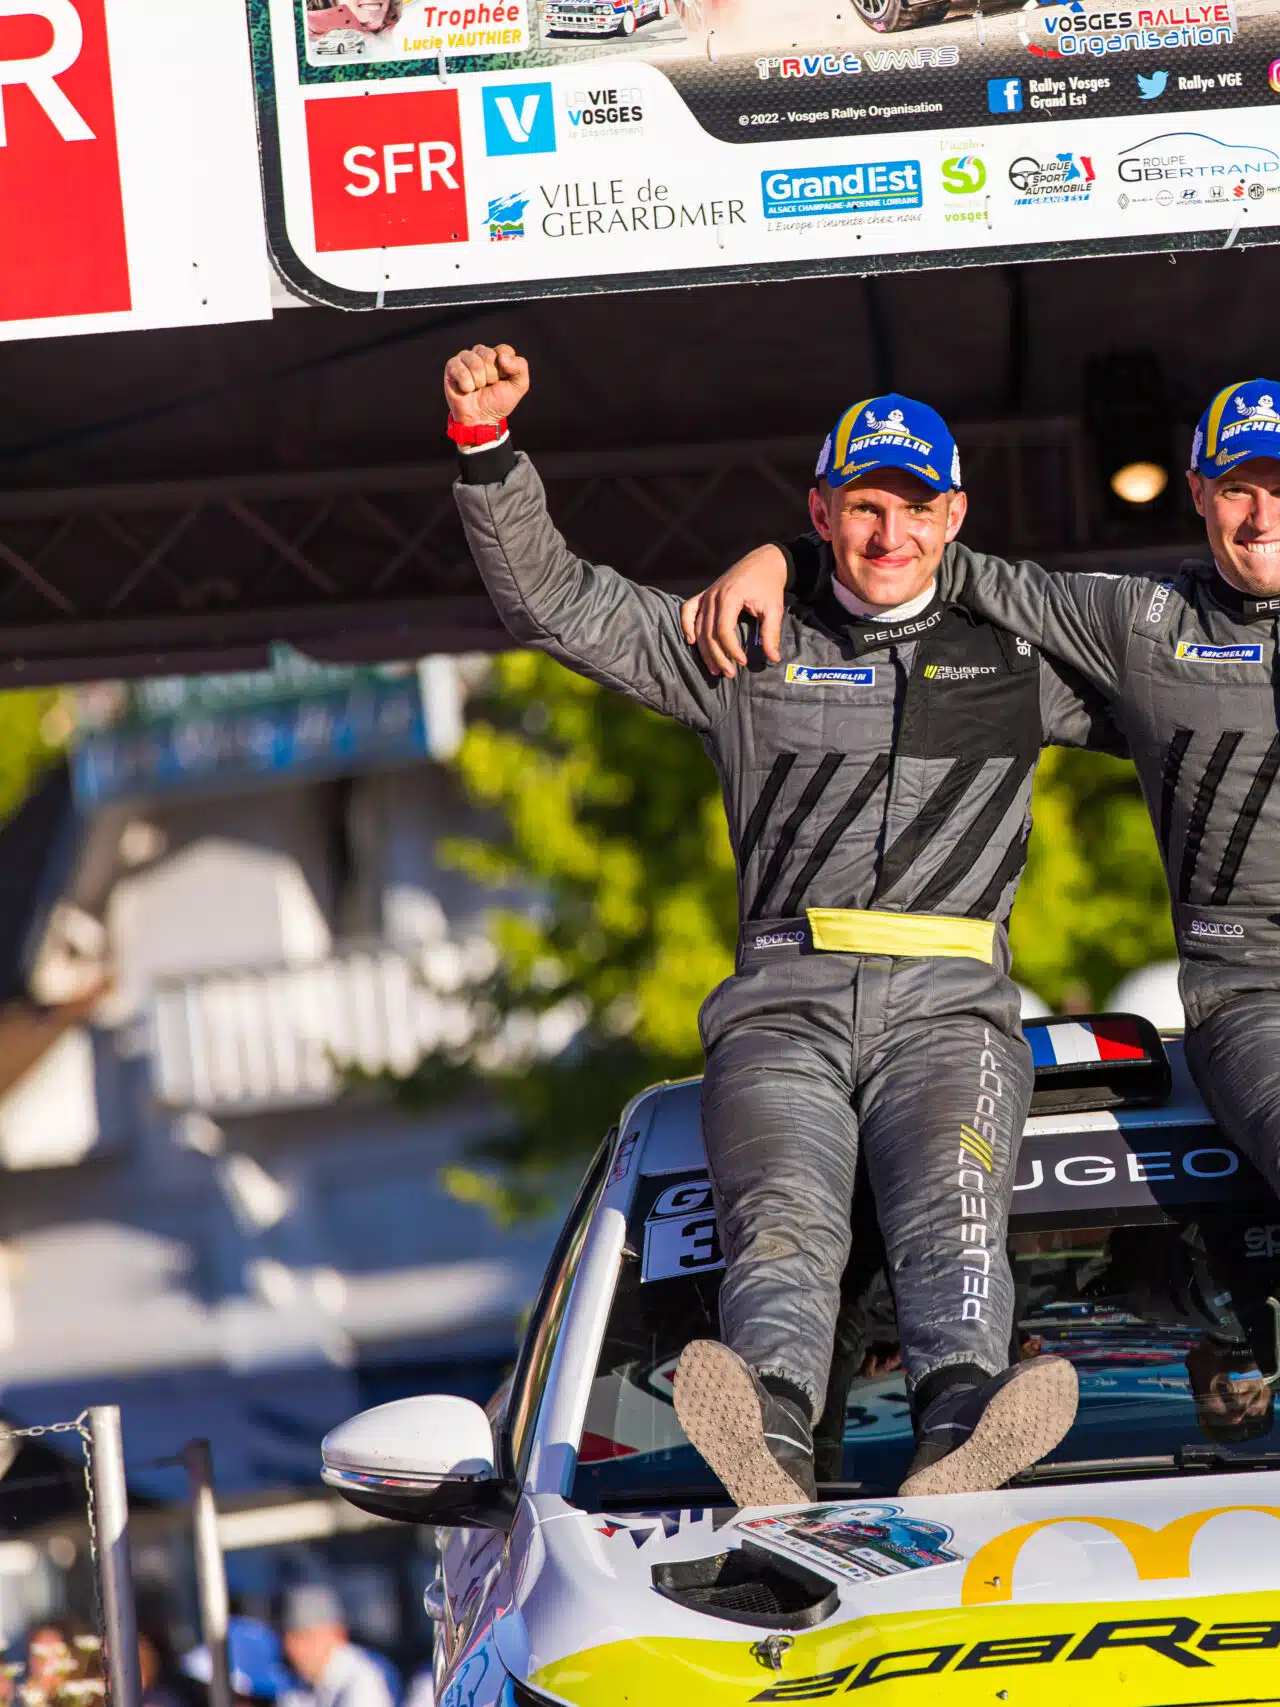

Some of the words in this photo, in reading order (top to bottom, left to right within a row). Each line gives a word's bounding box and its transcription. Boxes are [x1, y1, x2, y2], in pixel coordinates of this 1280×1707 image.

[424, 6, 519, 29] Trophée
[1044, 12, 1132, 34] VOSGES
[1138, 5, 1230, 28] RALLYE
[404, 36, 442, 51] Lucie
[447, 29, 522, 48] VAUTHIER
[1059, 26, 1233, 57] Organisation
[1029, 78, 1066, 96] Rallye
[1068, 77, 1110, 93] Vosges
[1178, 76, 1215, 92] Rallye
[1217, 73, 1242, 87] VGE
[588, 89, 618, 105] VIE
[1030, 93, 1066, 109] Grand
[1069, 93, 1087, 106] Est
[568, 106, 643, 126] VOSGES
[751, 113, 779, 125] 2022
[787, 109, 829, 126] Vosges
[831, 107, 867, 124] Rallye
[869, 102, 943, 122] Organisation
[343, 140, 460, 198] SFR
[1041, 162, 1070, 172] LIGUE
[1033, 174, 1067, 184] SPORT
[540, 180, 624, 208] VILLE
[637, 178, 668, 202] de
[1025, 183, 1092, 195] AUTOMOBILE
[541, 199, 747, 238] GERARDMER
[768, 206, 796, 215] ALSACE
[944, 210, 988, 223] vosges
[849, 435, 930, 456] MICHELIN
[1147, 584, 1171, 623] arco
[863, 611, 942, 642] PEUGEOT
[1200, 649, 1254, 658] MICHELIN
[811, 671, 867, 681] MICHELIN
[937, 665, 998, 675] PEUGEOT
[1191, 919, 1244, 936] sparco
[755, 931, 805, 948] sparco
[1012, 1148, 1239, 1191] UGEO
